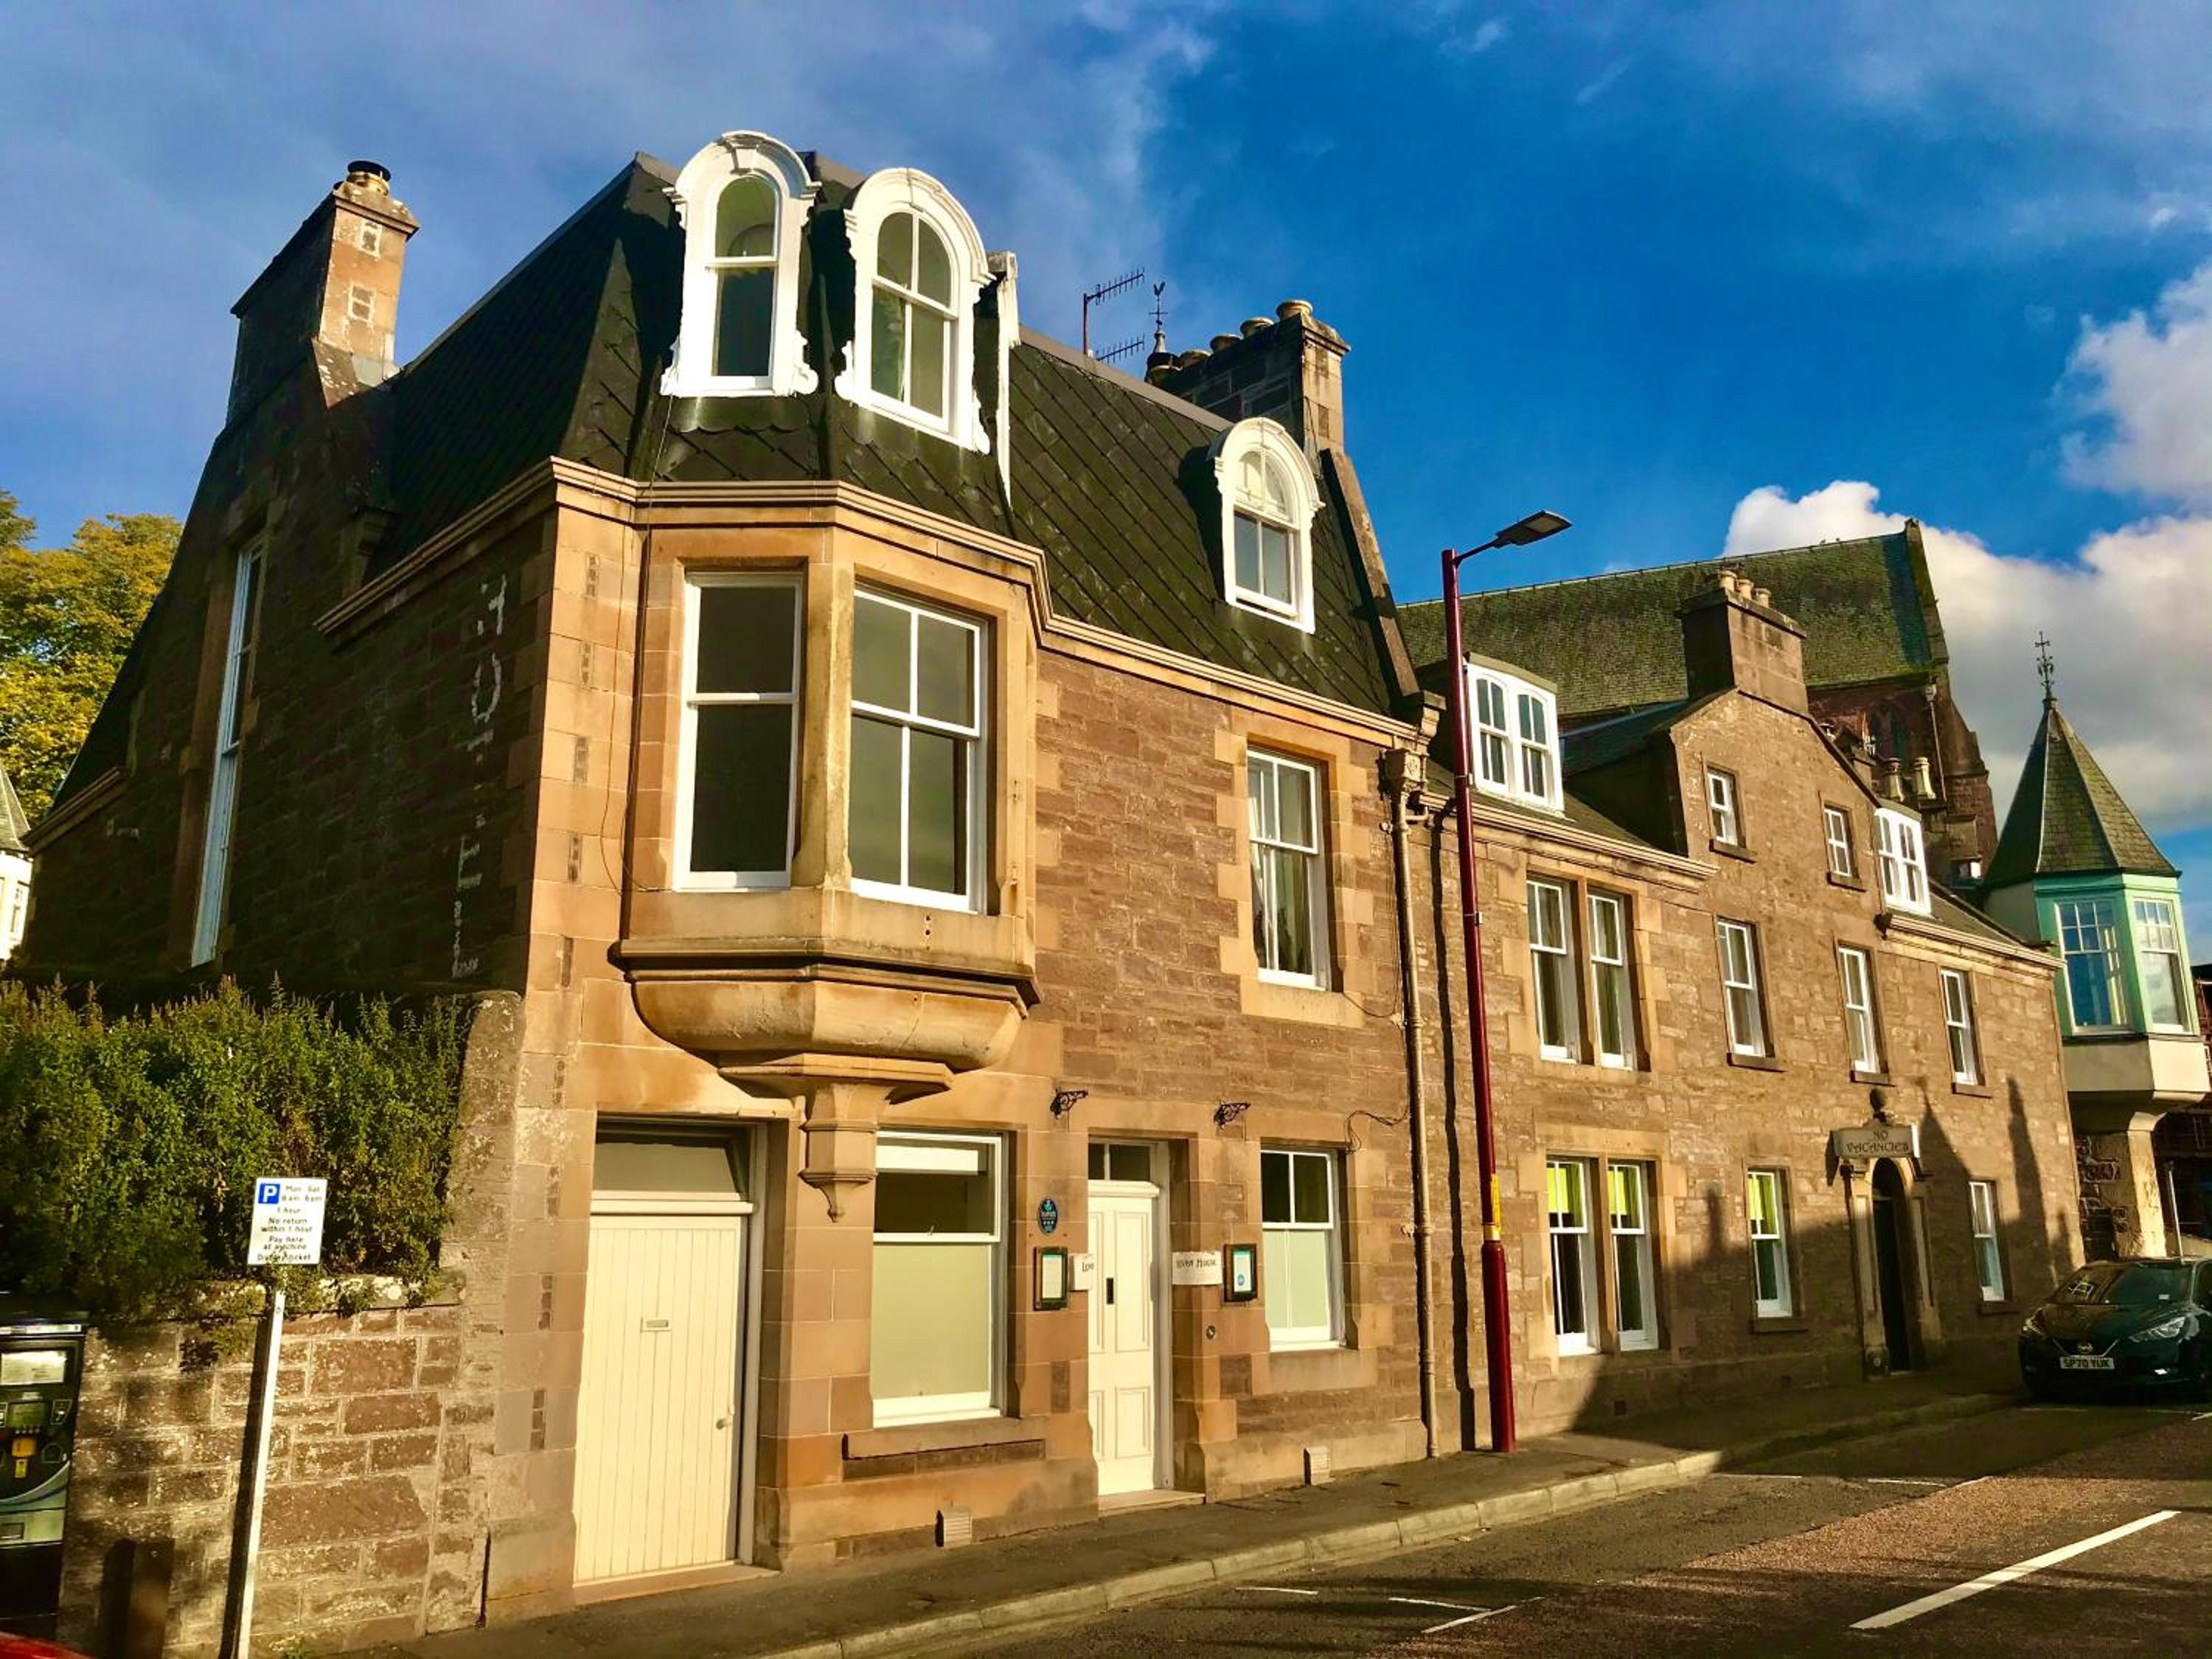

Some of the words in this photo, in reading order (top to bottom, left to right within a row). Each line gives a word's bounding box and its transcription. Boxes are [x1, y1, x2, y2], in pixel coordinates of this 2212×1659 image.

[1874, 1130, 1888, 1140] NO
[1846, 1141, 1908, 1154] VACANCIES
[262, 1185, 277, 1203] P
[268, 1235, 282, 1243] Pay
